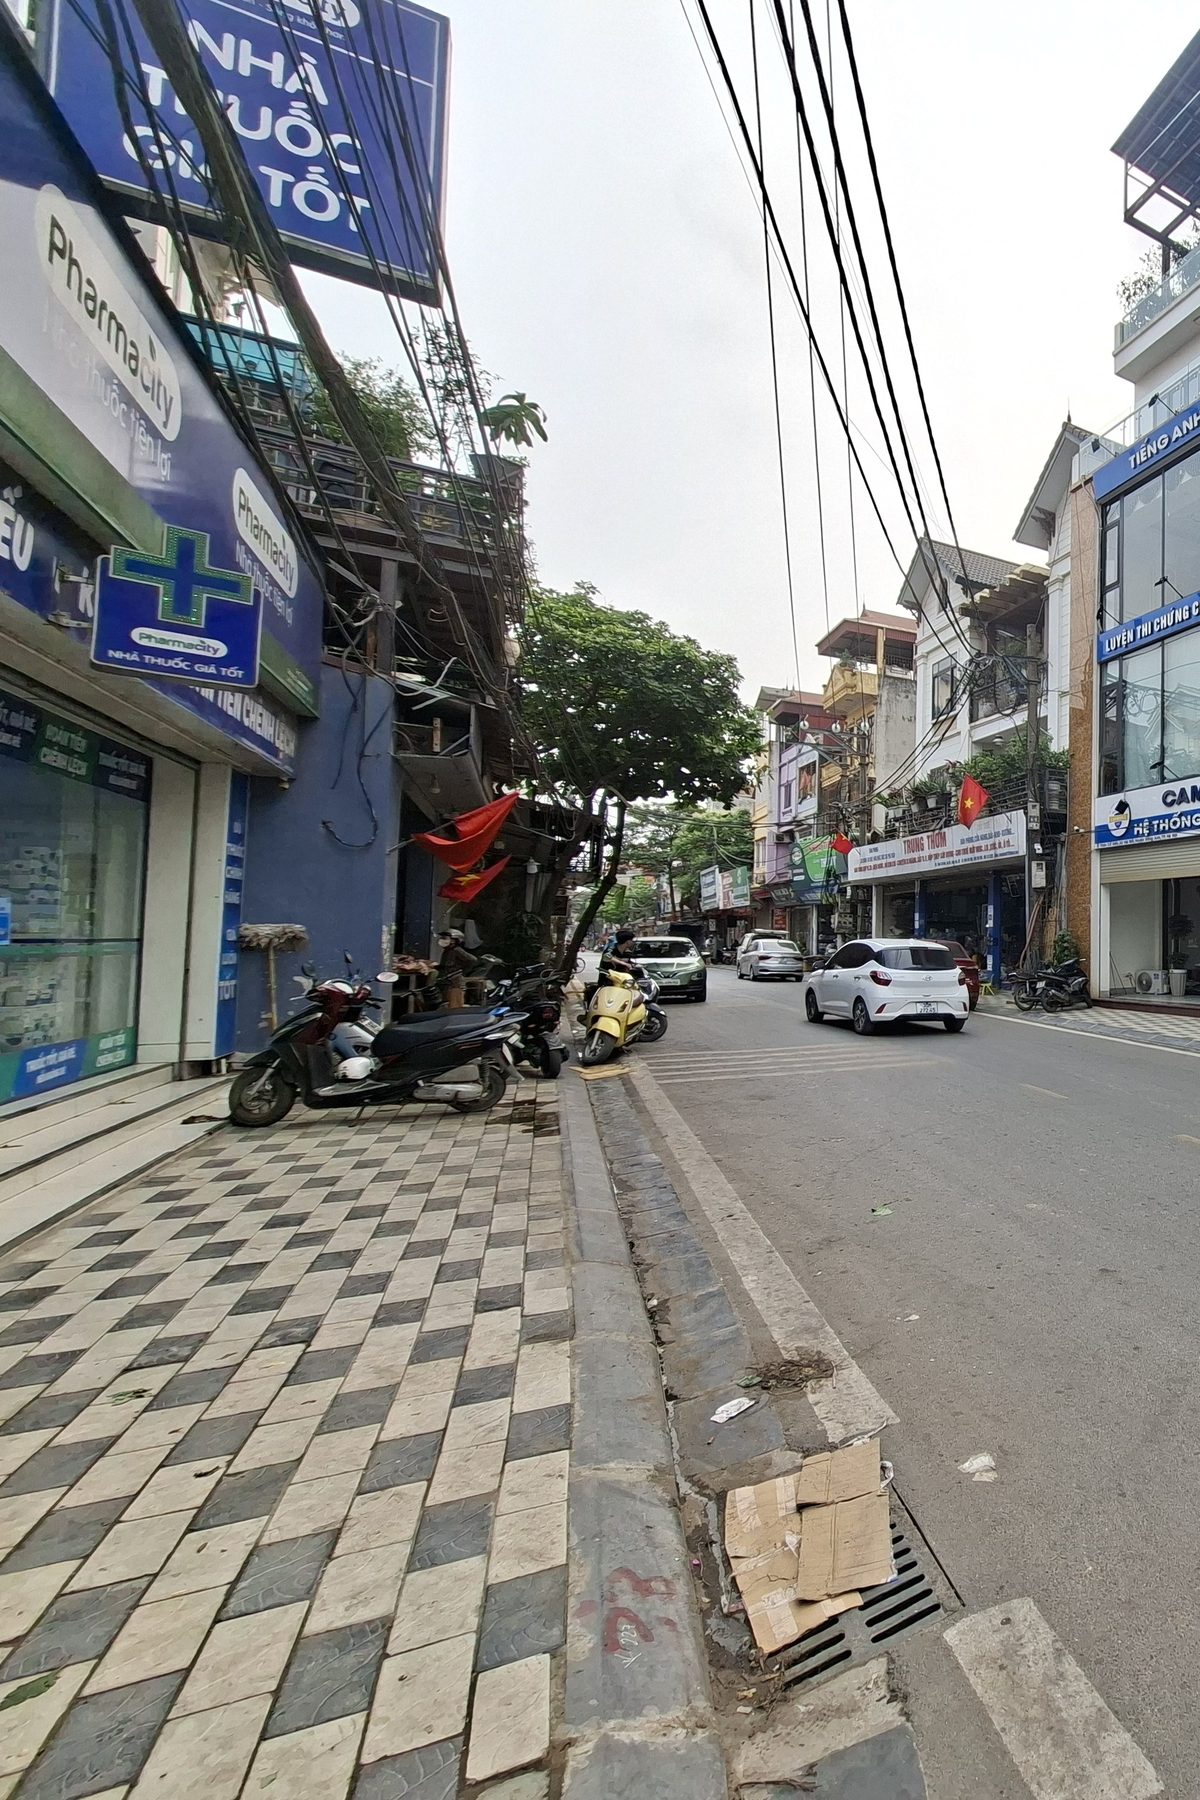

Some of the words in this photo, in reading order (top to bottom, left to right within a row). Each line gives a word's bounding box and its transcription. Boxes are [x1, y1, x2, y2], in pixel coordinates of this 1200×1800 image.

[187, 19, 328, 106] NHÀ
[258, 166, 371, 233] TỐT
[47, 214, 174, 430] Pharmacity
[1128, 433, 1169, 470] TIẾNG
[238, 487, 296, 592] Pharmacity
[138, 631, 221, 656] Pharmacity
[1105, 627, 1134, 652] LUYỆN
[1136, 622, 1152, 641] THI
[1153, 604, 1190, 635] CHỨNG
[107, 649, 141, 664] NHÀ
[143, 653, 191, 672] THUỐC
[194, 661, 218, 675] GIÁ
[220, 664, 245, 679] TỐT
[903, 836, 924, 854] TRUNG
[927, 831, 947, 850] THƠM
[1134, 819, 1150, 836] HỆ
